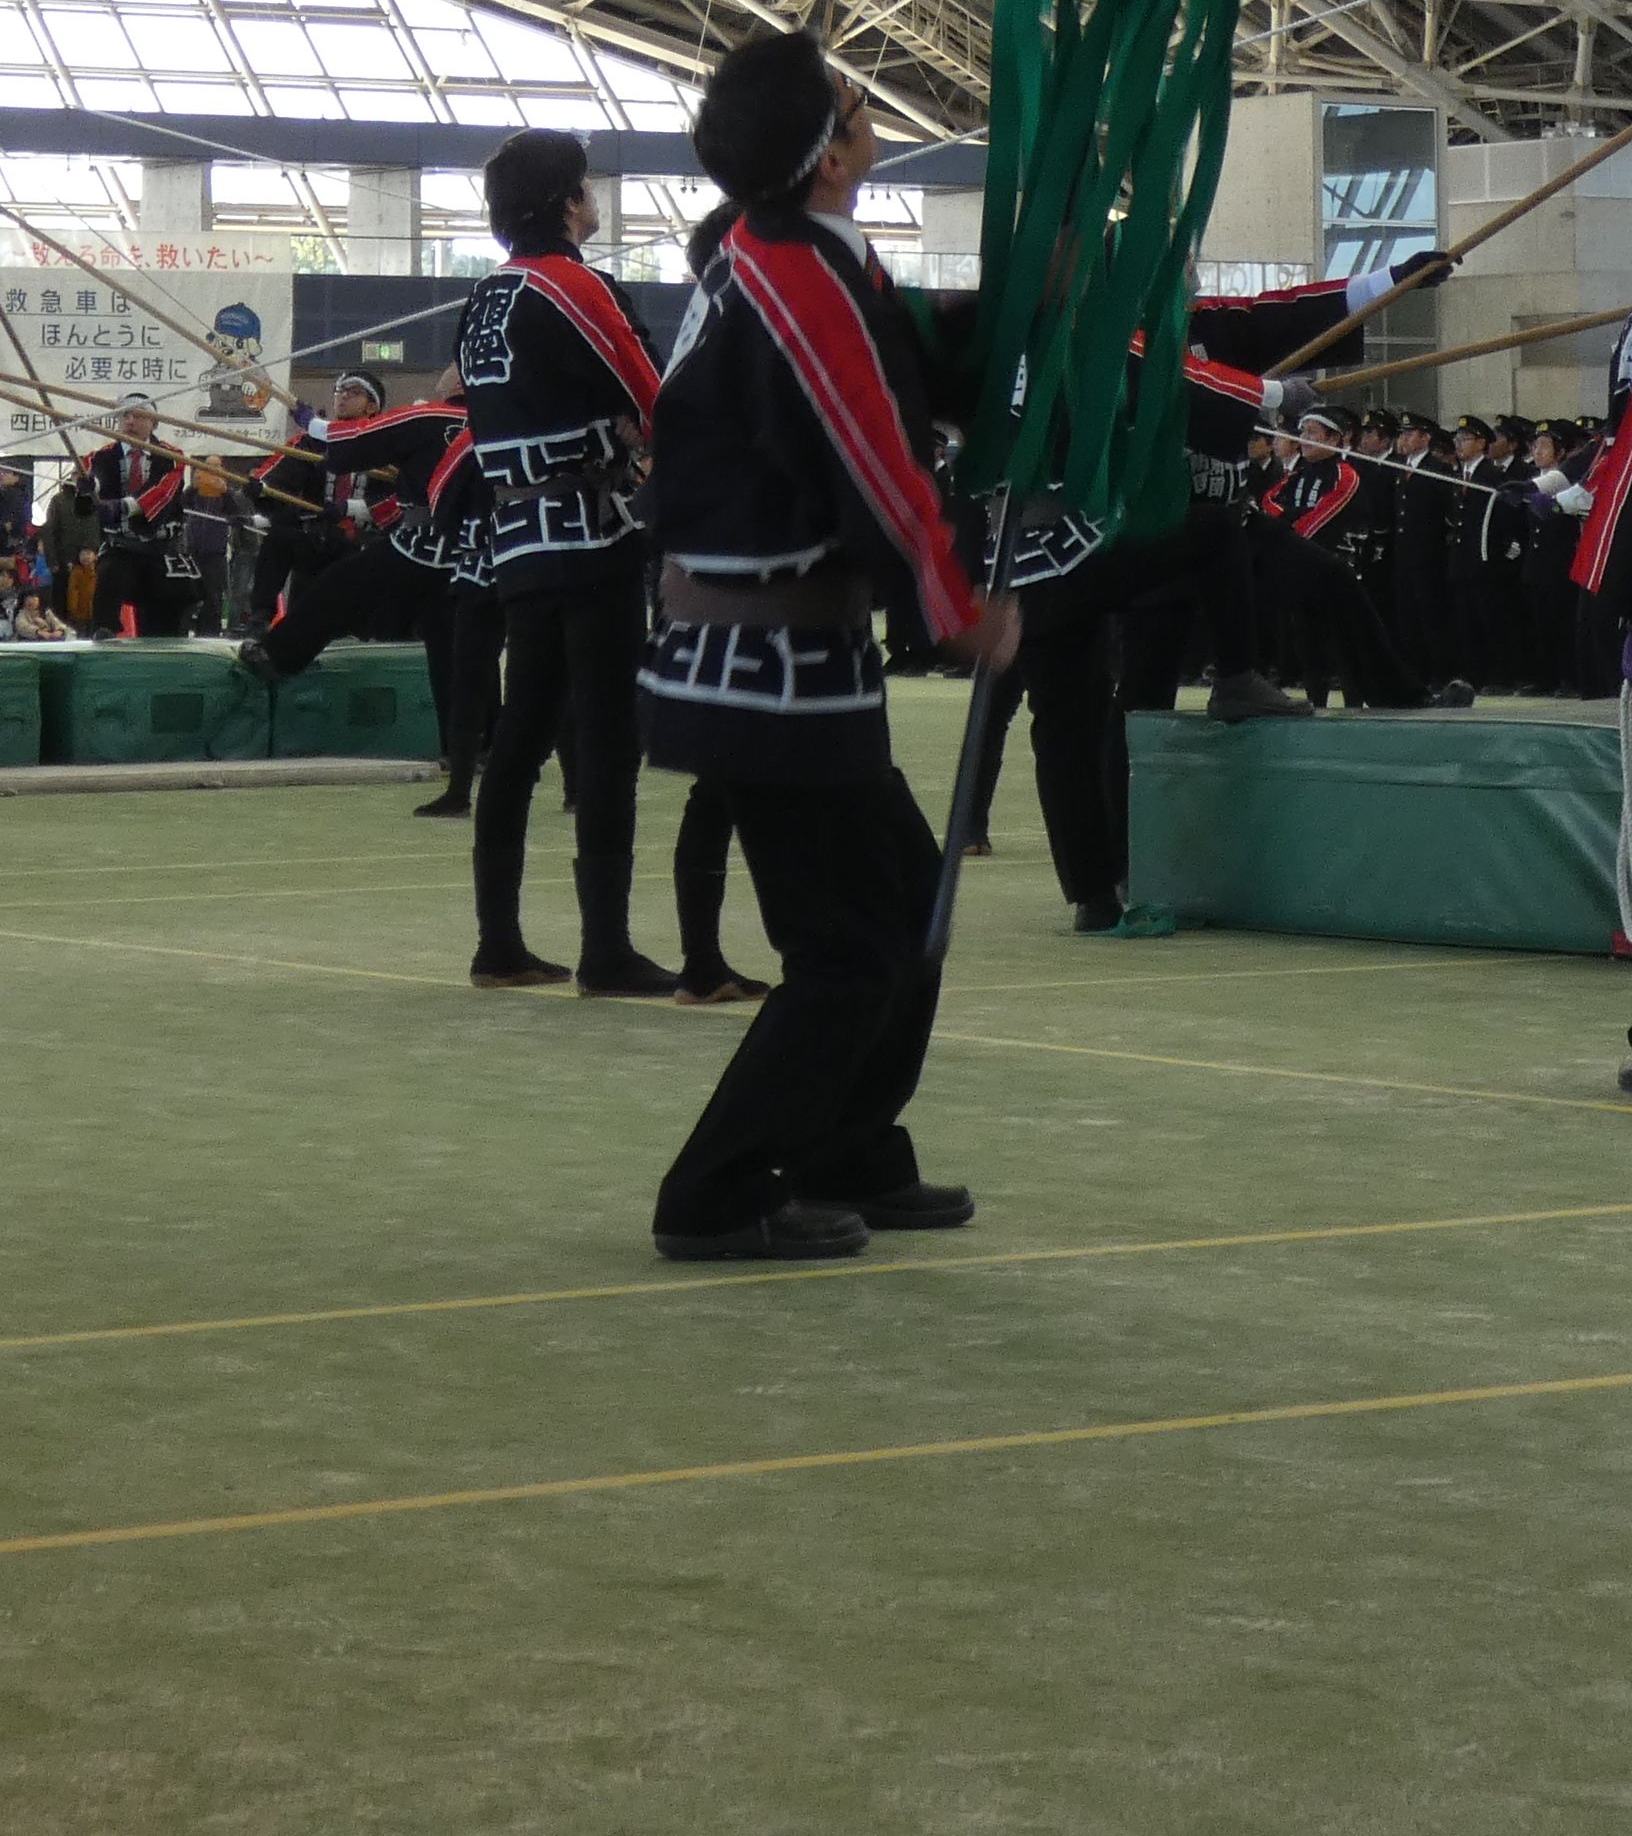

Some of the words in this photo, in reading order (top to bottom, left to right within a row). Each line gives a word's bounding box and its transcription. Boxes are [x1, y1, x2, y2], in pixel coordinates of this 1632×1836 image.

[5, 288, 132, 314] 救急車は
[41, 323, 161, 347] ほんとうに
[64, 357, 188, 381] 必要な時に
